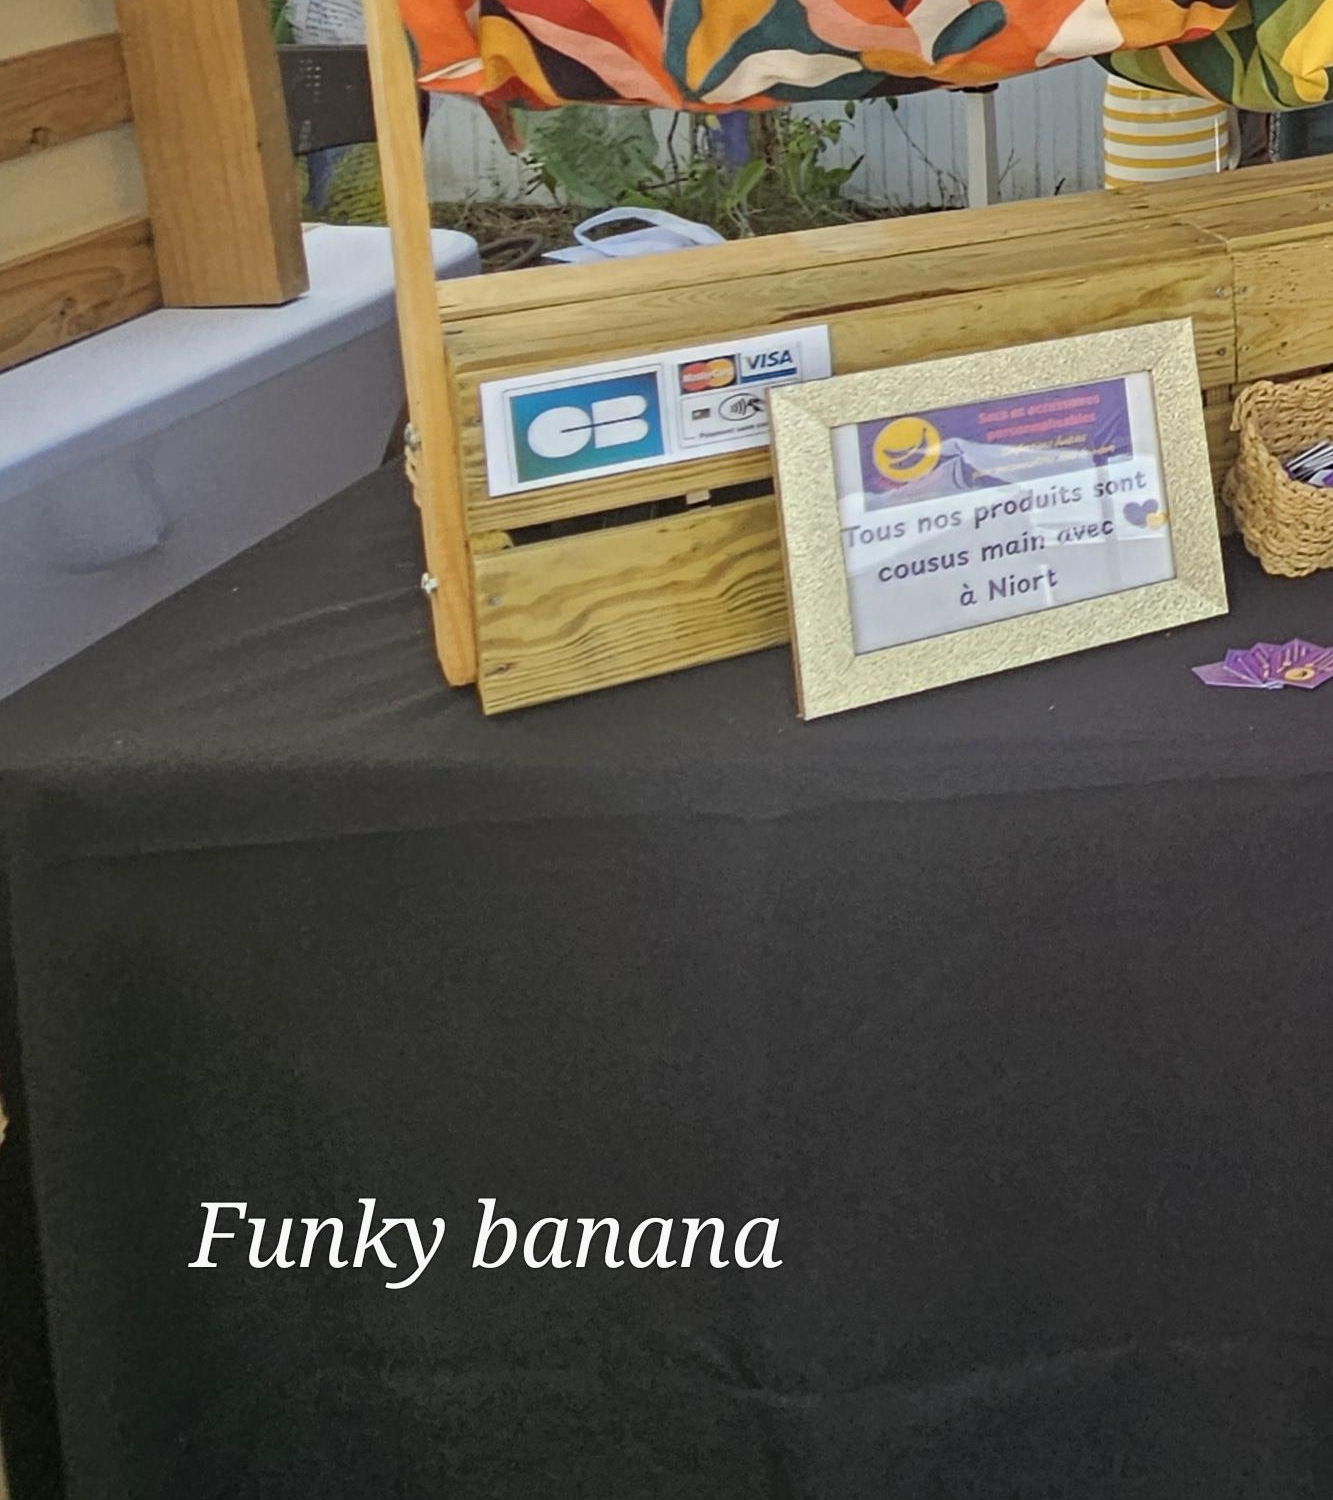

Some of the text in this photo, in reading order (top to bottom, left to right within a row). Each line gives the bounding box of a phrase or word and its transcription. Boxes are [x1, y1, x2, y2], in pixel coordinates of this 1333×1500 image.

[748, 350, 793, 370] VISA
[841, 471, 1147, 548] Tous nos produits sont
[878, 518, 1115, 582] cousus main avec
[960, 568, 1058, 606] à Niort
